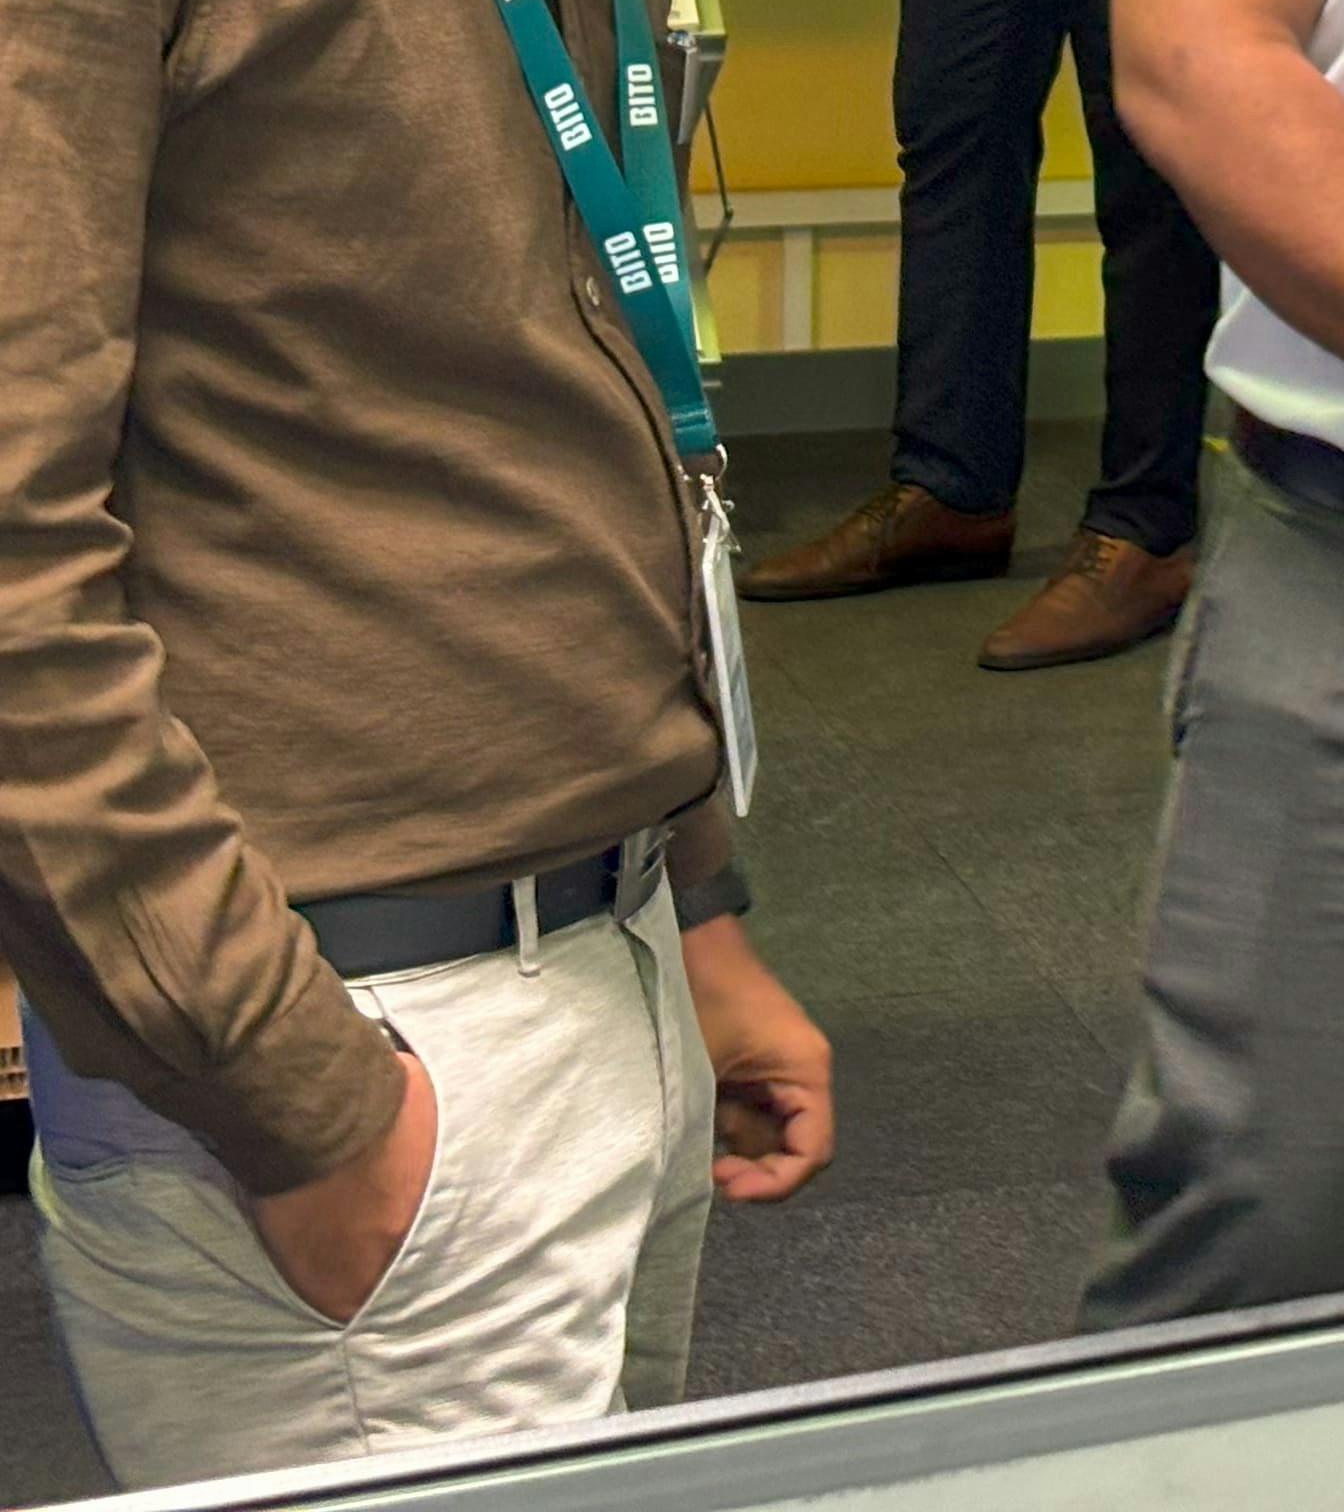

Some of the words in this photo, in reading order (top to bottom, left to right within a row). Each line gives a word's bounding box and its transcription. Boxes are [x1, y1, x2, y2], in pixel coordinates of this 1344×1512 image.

[544, 82, 593, 152] BITO
[627, 63, 658, 127] BITO
[604, 230, 653, 295] BITO
